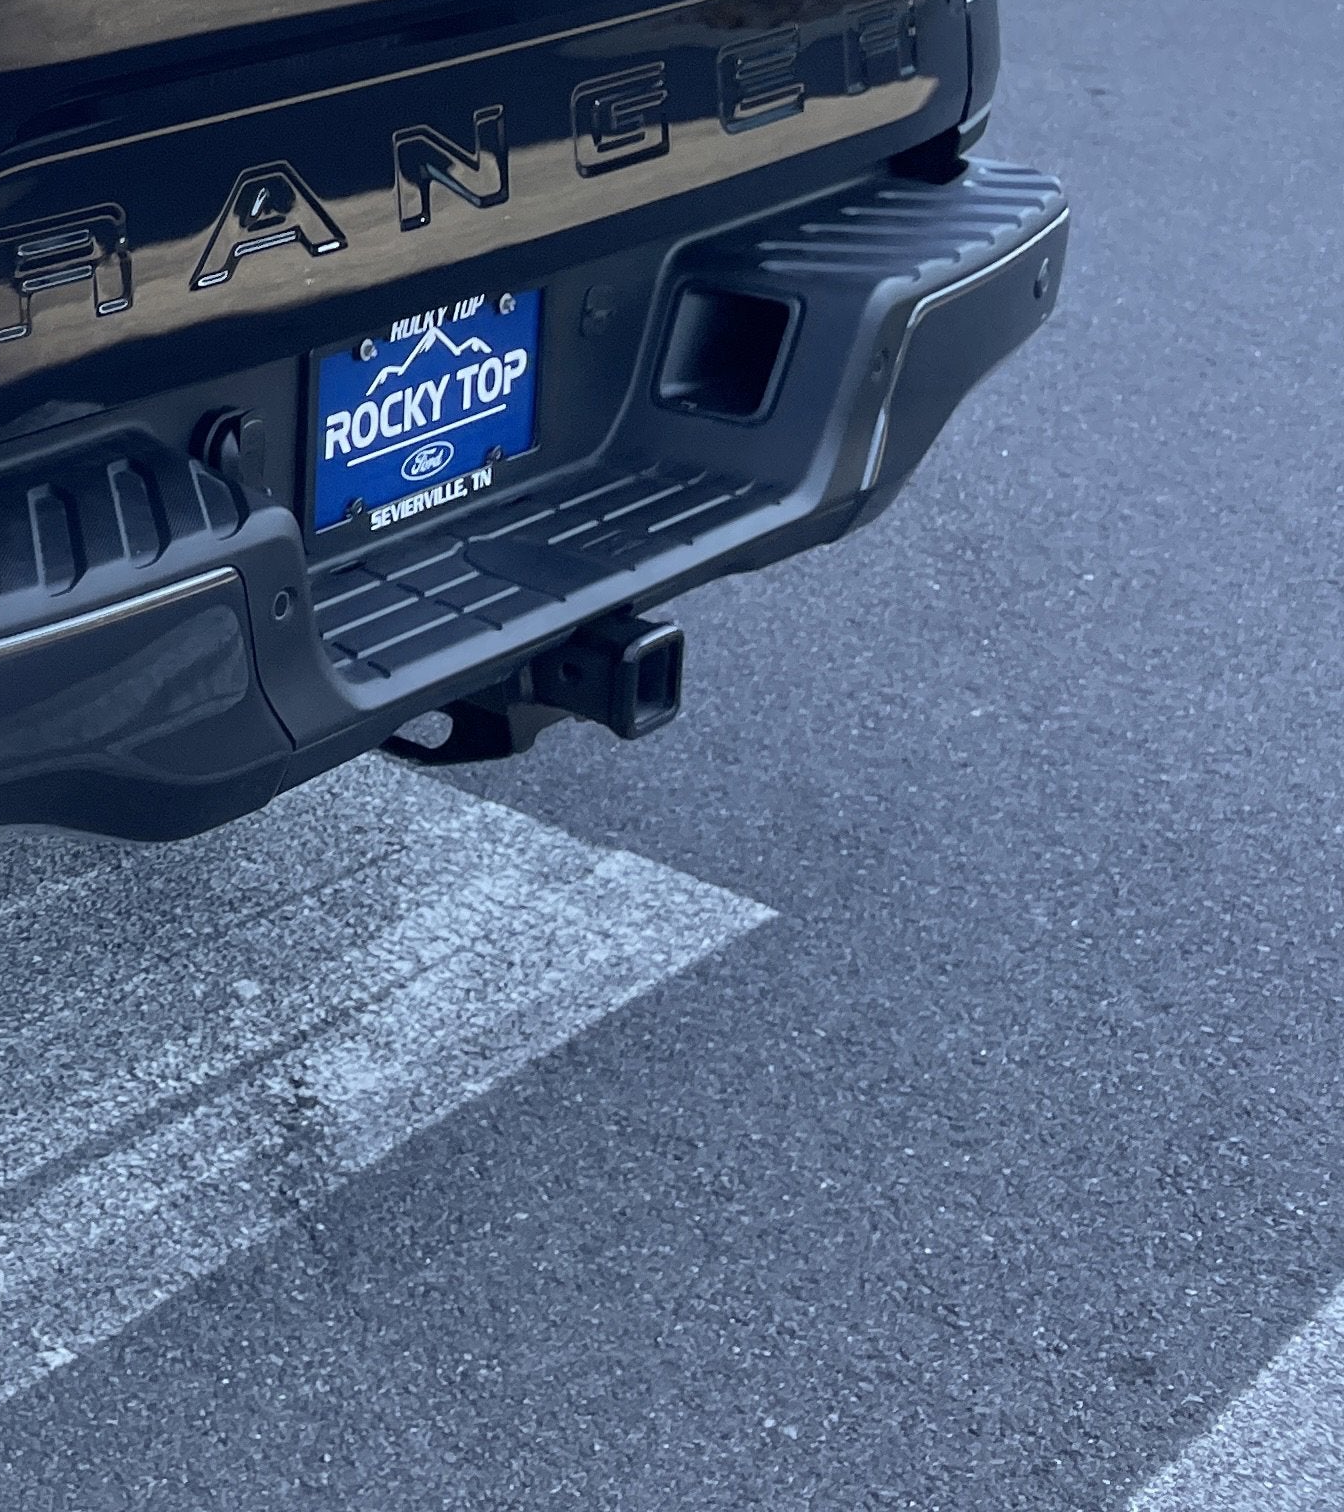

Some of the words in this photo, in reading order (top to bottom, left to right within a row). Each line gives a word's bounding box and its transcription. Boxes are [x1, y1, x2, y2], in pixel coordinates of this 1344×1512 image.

[324, 373, 451, 461] ROCKY
[455, 348, 528, 411] TOP
[411, 445, 444, 476] Ford
[370, 476, 468, 531] SEVIERVILLE,
[471, 467, 493, 492] TN
